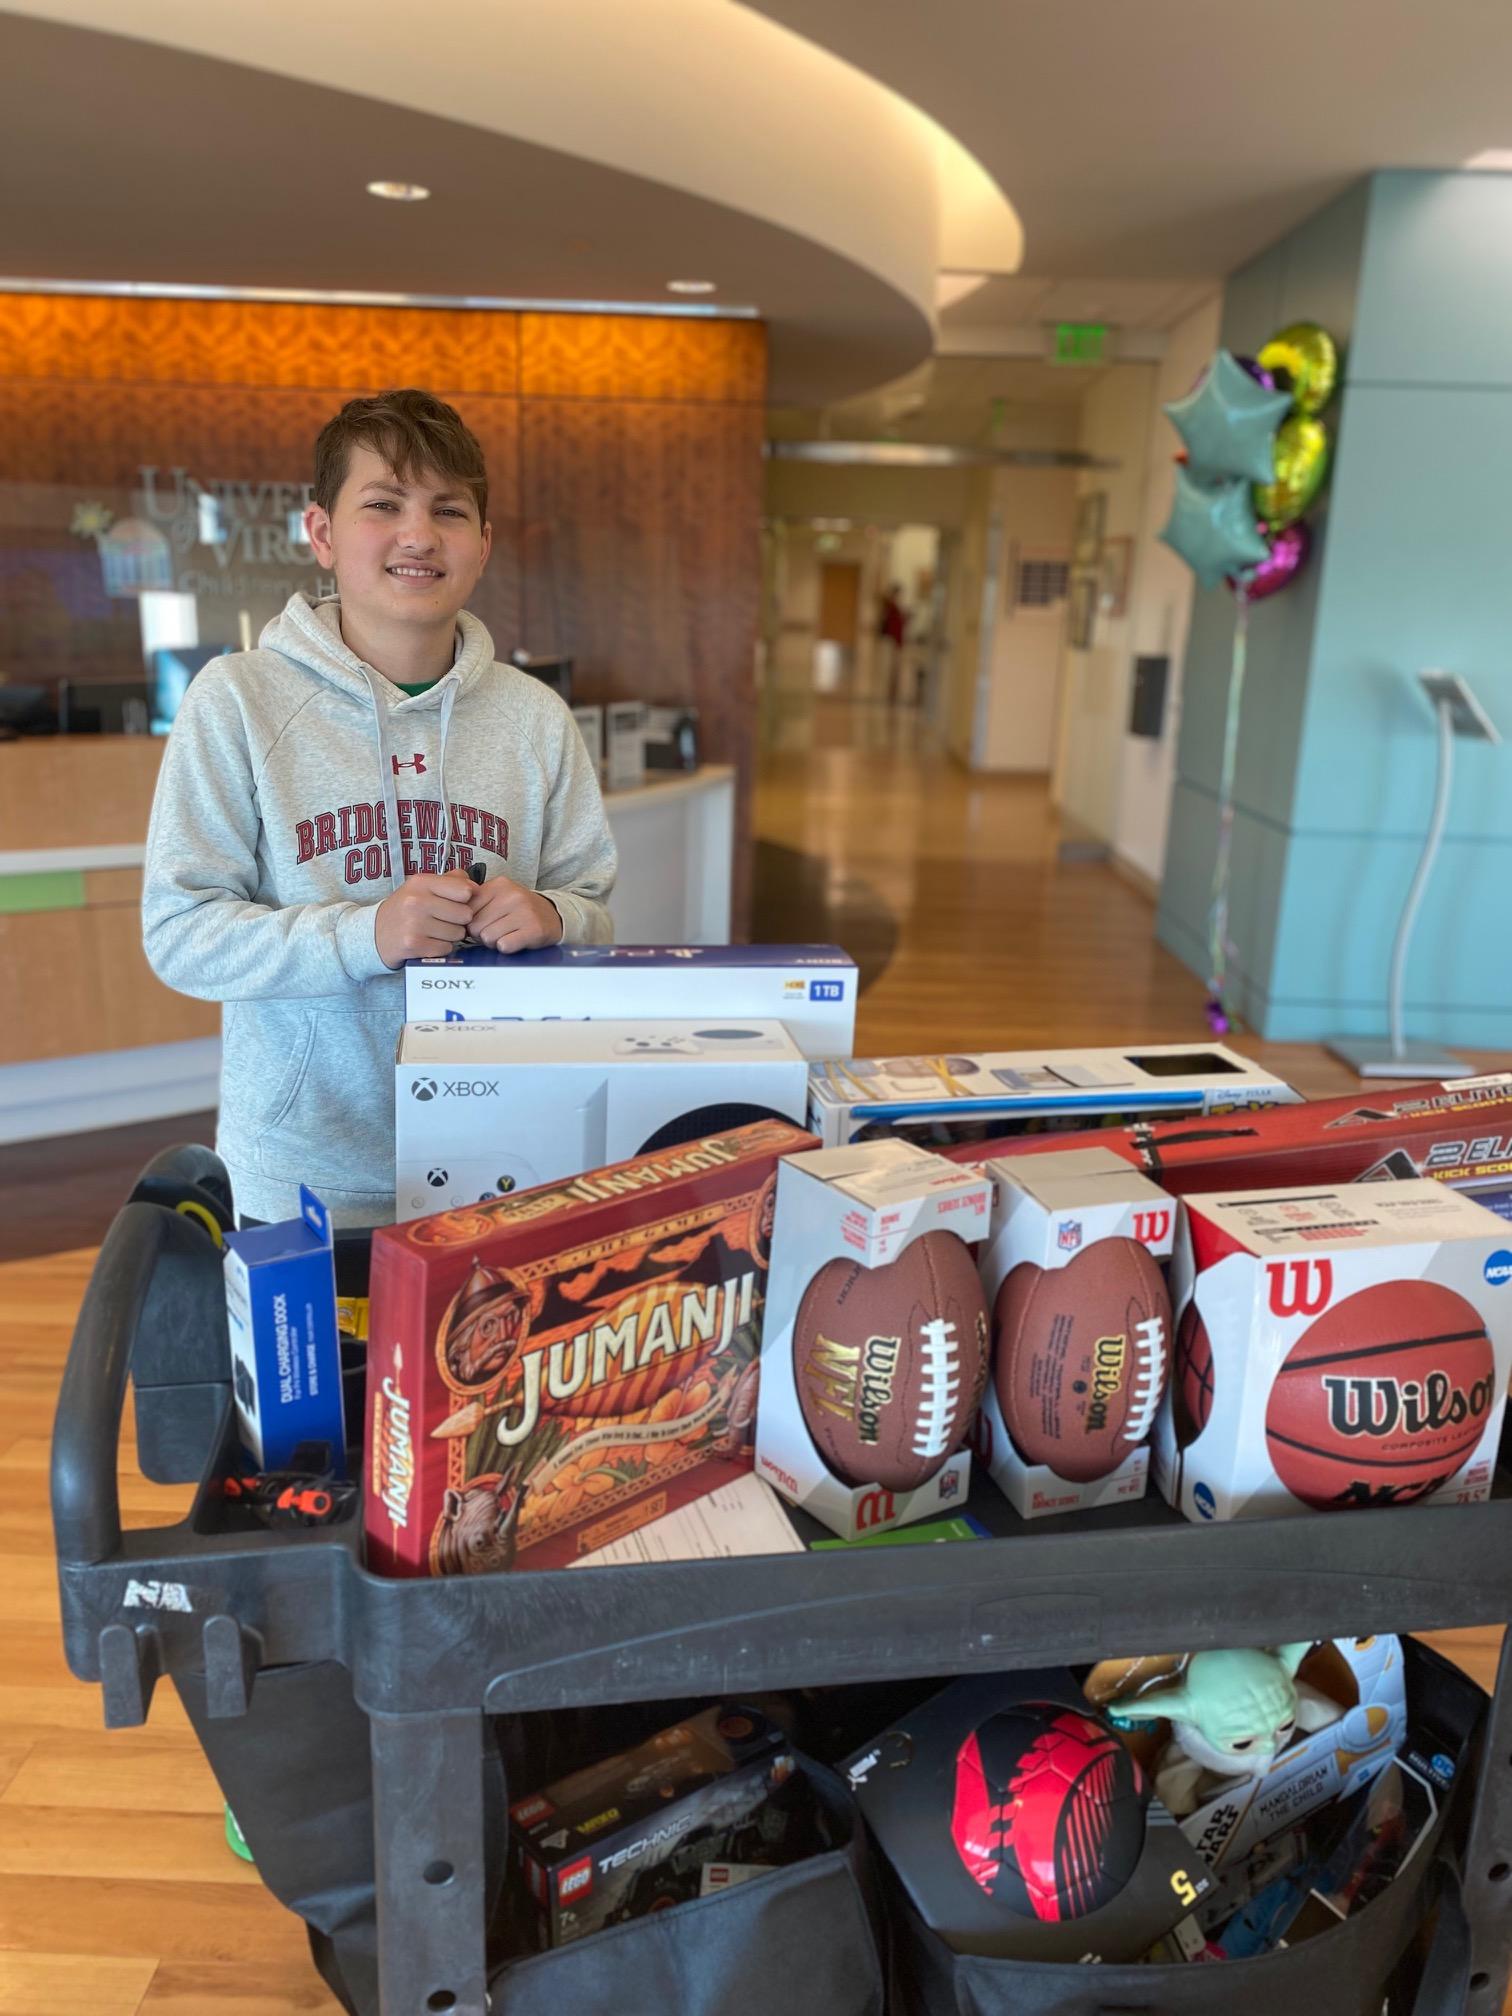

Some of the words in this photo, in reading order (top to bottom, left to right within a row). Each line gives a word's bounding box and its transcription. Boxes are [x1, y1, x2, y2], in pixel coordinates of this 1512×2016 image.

[296, 800, 510, 865] BRIDGEWATER
[421, 979, 475, 989] SONY
[443, 1081, 500, 1097] XBOX
[567, 1139, 737, 1203] JUMANJI
[1432, 1167, 1471, 1180] KICK
[273, 1293, 288, 1324] DOCK
[276, 1324, 291, 1376] CHARGING
[496, 1271, 756, 1446] JUMANJI
[281, 1376, 293, 1403] DUAL
[803, 1333, 860, 1421] NFL
[859, 1336, 902, 1446] Wilson
[1086, 1334, 1126, 1435] Wilson
[382, 1377, 410, 1528] JUMANJI
[1381, 1437, 1448, 1451] COMPOSITE
[517, 1801, 548, 1822] LEGO
[1195, 1803, 1236, 1852] TAR
[598, 1814, 696, 1875] TECHNIC
[561, 1868, 591, 1895] LEGO
[1170, 1869, 1198, 1907] 5
